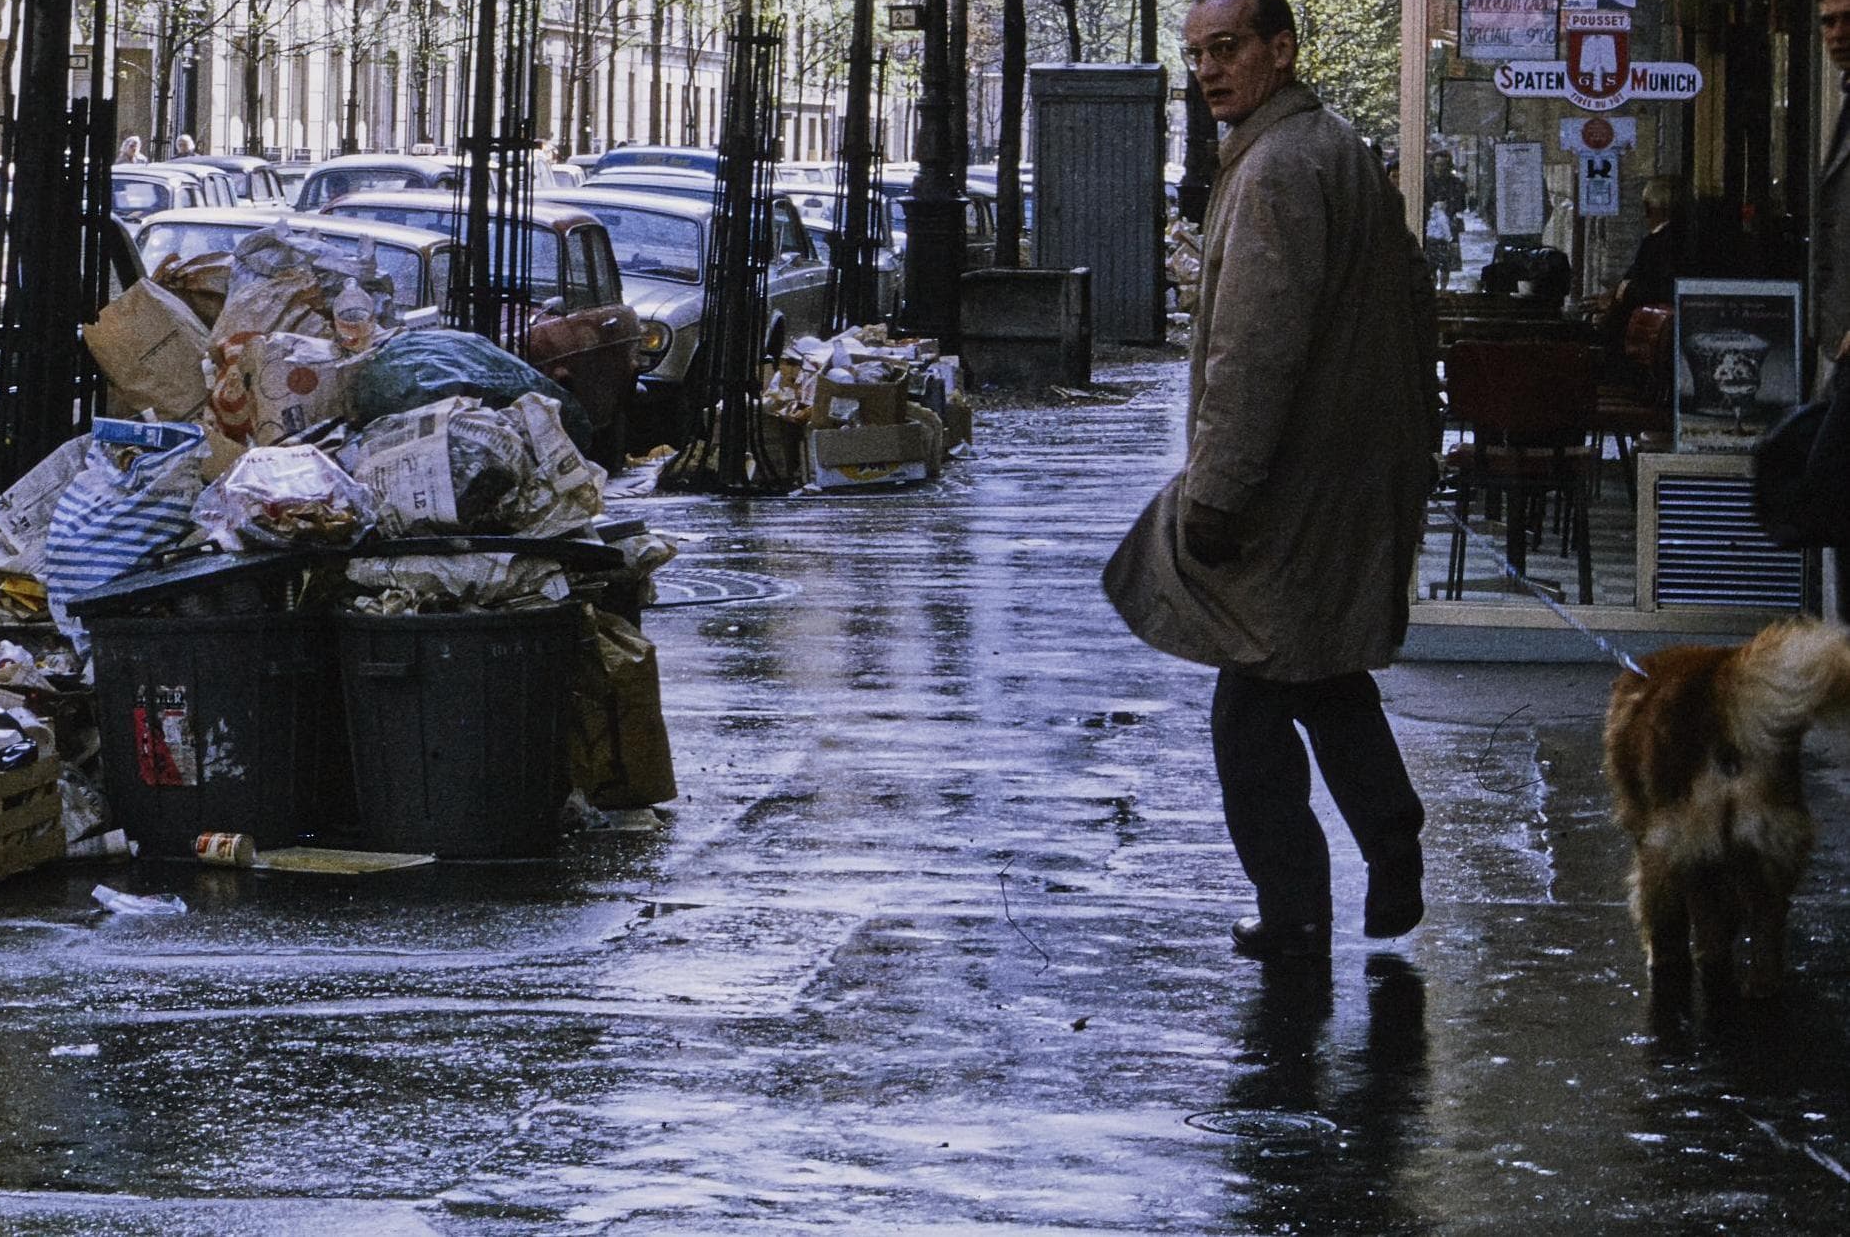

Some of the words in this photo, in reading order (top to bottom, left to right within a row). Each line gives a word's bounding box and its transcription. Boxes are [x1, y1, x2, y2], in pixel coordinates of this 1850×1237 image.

[1572, 15, 1625, 26] POUSSET
[1500, 65, 1565, 90] SPATEN
[1631, 67, 1697, 92] MUNICH
